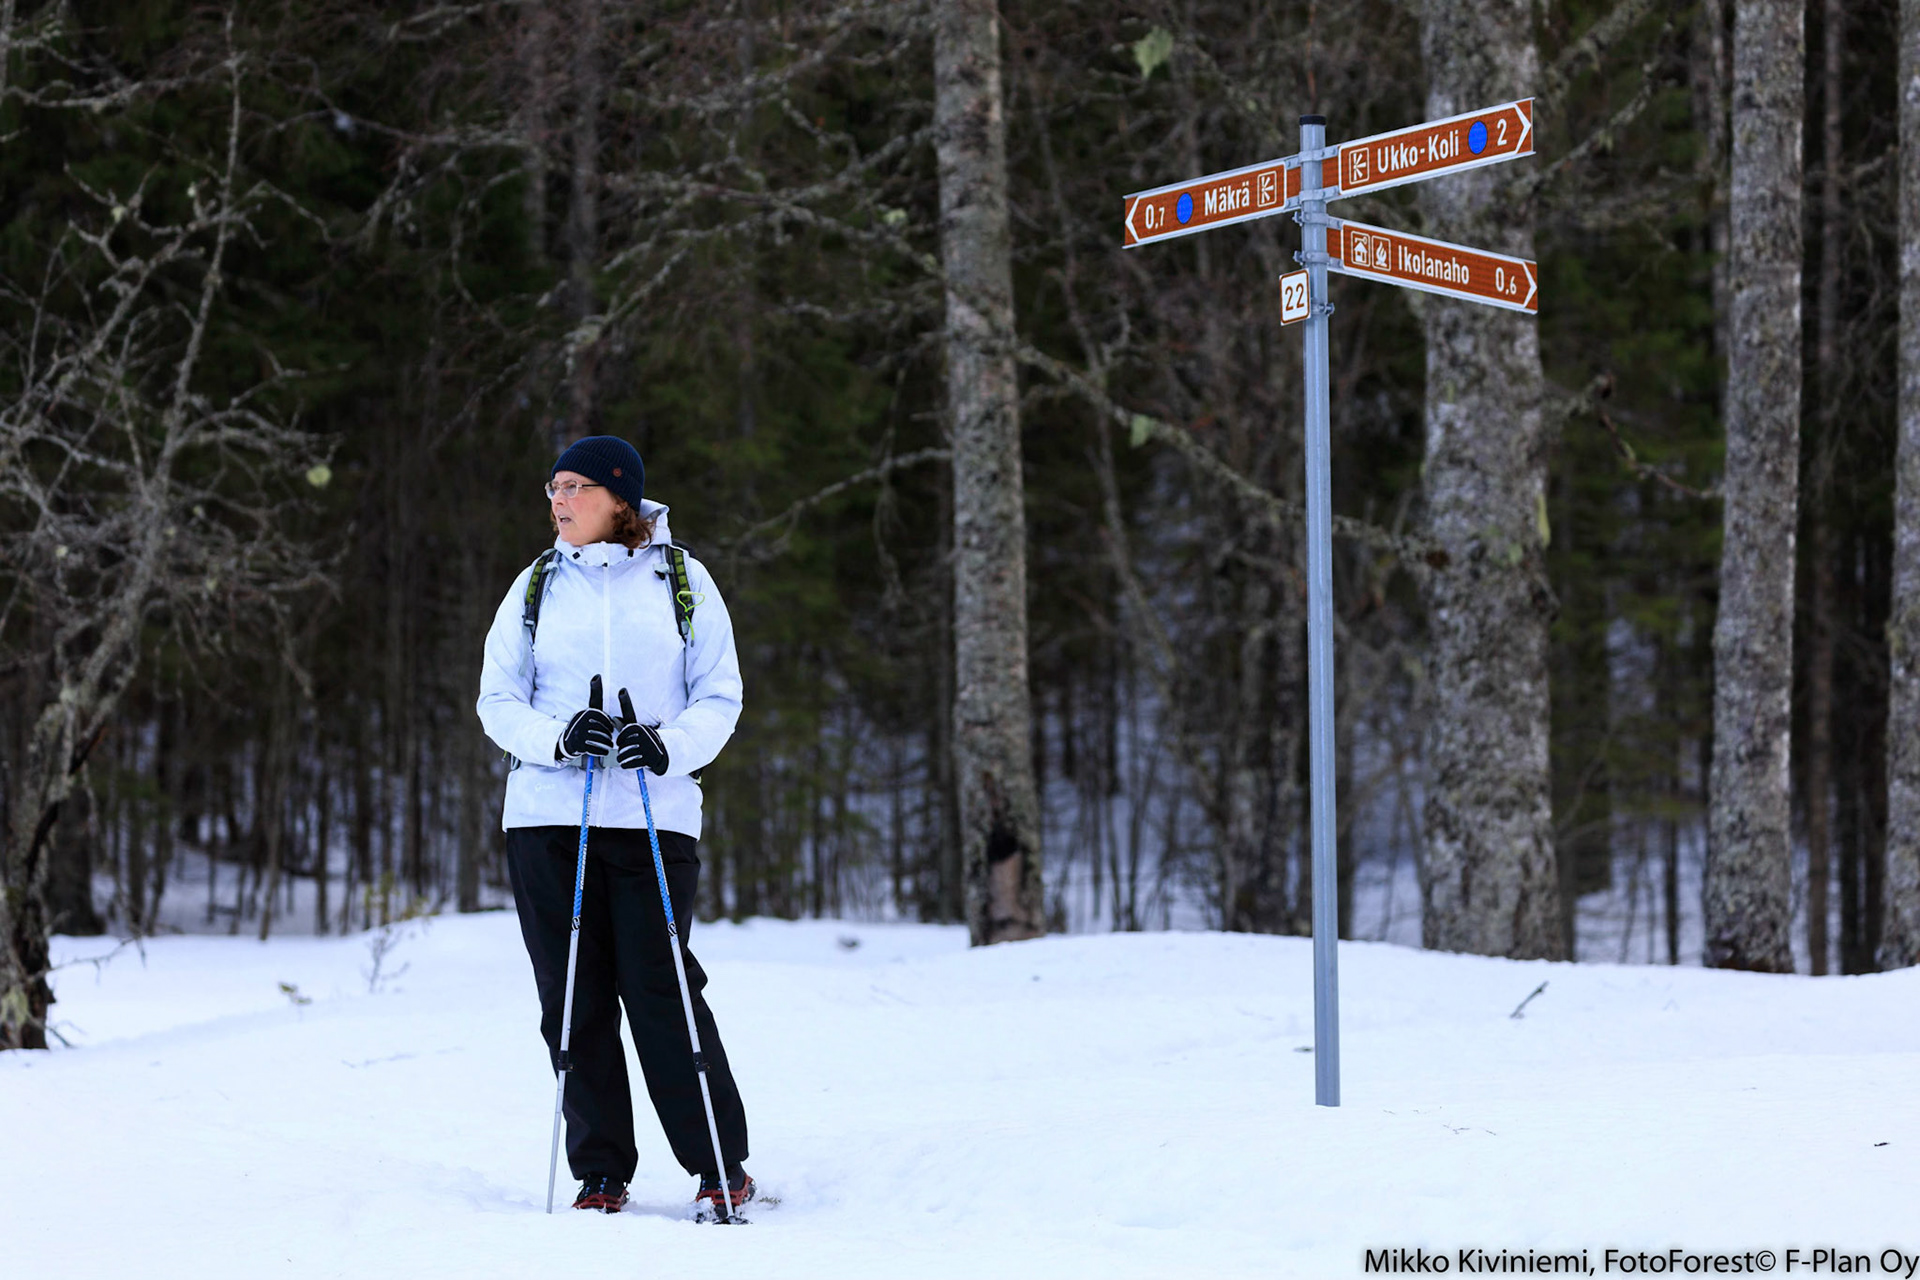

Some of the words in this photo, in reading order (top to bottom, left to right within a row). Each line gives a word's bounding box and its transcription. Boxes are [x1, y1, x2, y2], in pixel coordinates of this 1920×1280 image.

[1377, 129, 1459, 174] Ukko-Koli
[1496, 118, 1508, 147] 2
[1145, 204, 1166, 231] 0,7
[1204, 180, 1250, 217] Mäkrä
[1398, 244, 1470, 285] Ikolanaho
[1495, 266, 1517, 295] 0,6
[1284, 282, 1305, 312] 22
